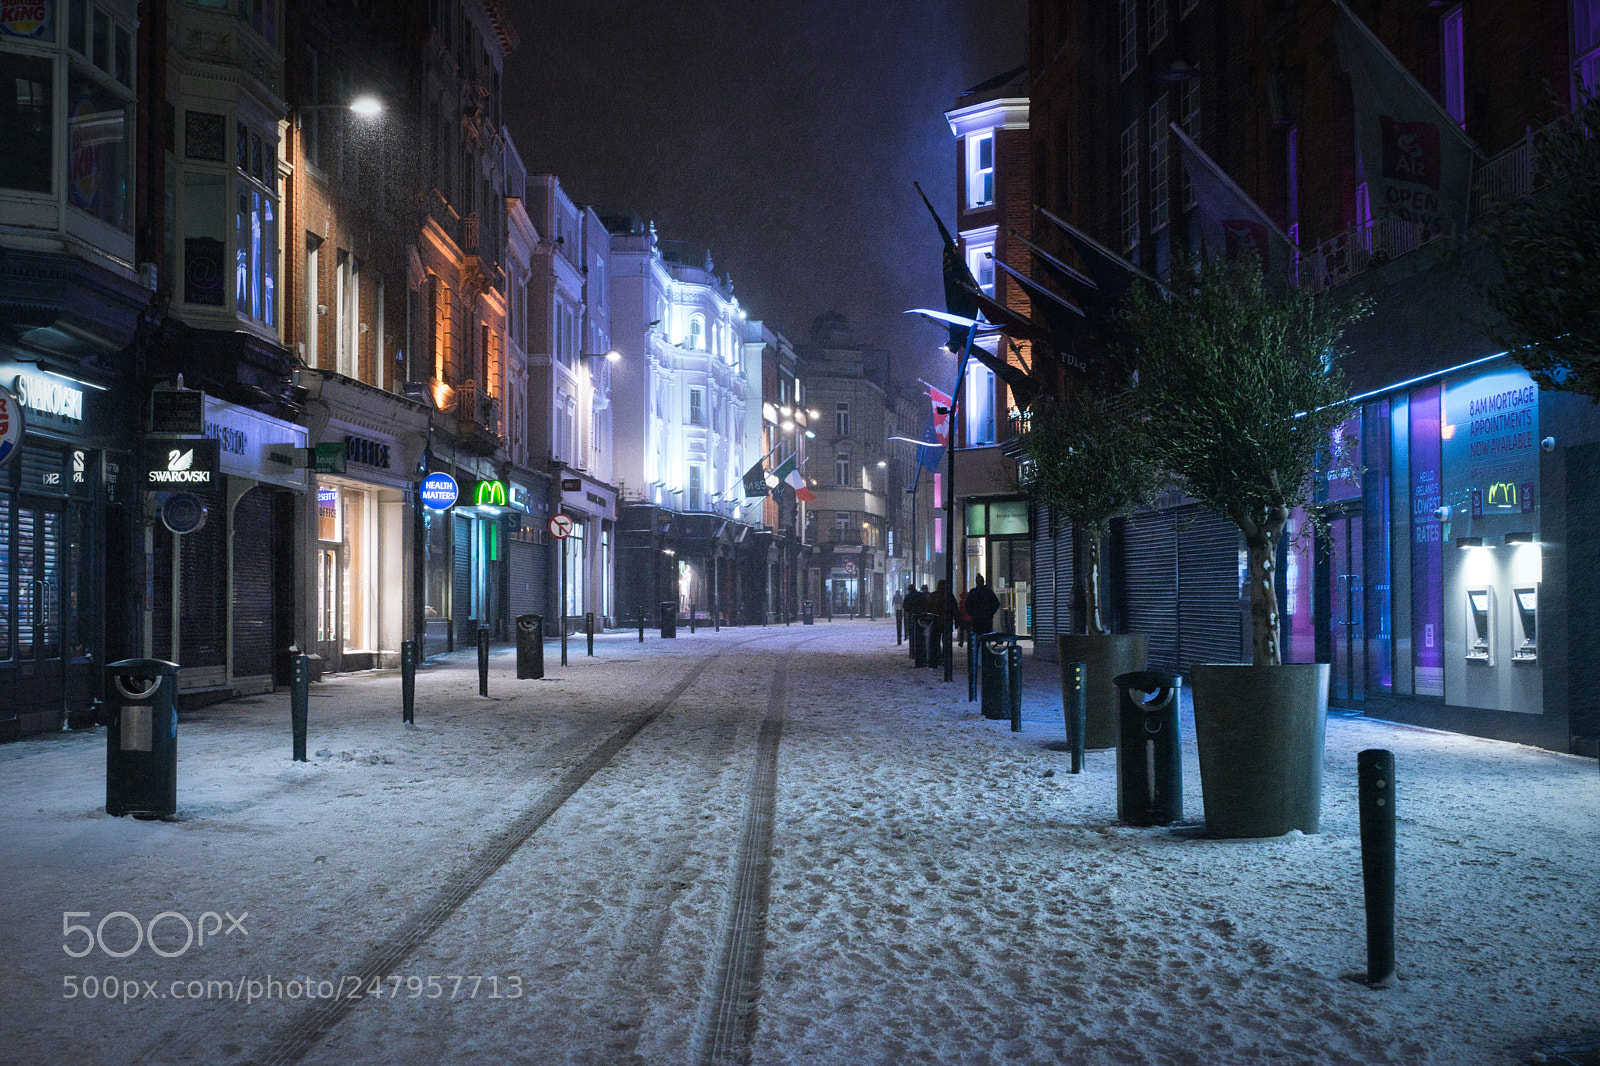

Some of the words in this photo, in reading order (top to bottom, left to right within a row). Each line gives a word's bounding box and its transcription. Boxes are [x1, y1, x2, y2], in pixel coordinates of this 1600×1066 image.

[0, 6, 46, 22] KING
[1386, 186, 1438, 212] OPEN
[18, 374, 83, 421] SWAROVSKI
[1488, 385, 1534, 412] MORTGAGE
[1470, 409, 1532, 437] APPOINTMENTS
[346, 435, 390, 469] OFFICE
[1470, 440, 1489, 458] NOW
[1490, 430, 1533, 455] AVAILABLE
[149, 470, 210, 482] SWAROVSKI
[425, 481, 453, 490] HEALTH
[1419, 470, 1435, 482] HELLO
[422, 491, 456, 500] MATTERS
[1413, 495, 1441, 515] LOWEST
[319, 507, 337, 518] OFFICE
[1416, 524, 1440, 543] RATES
